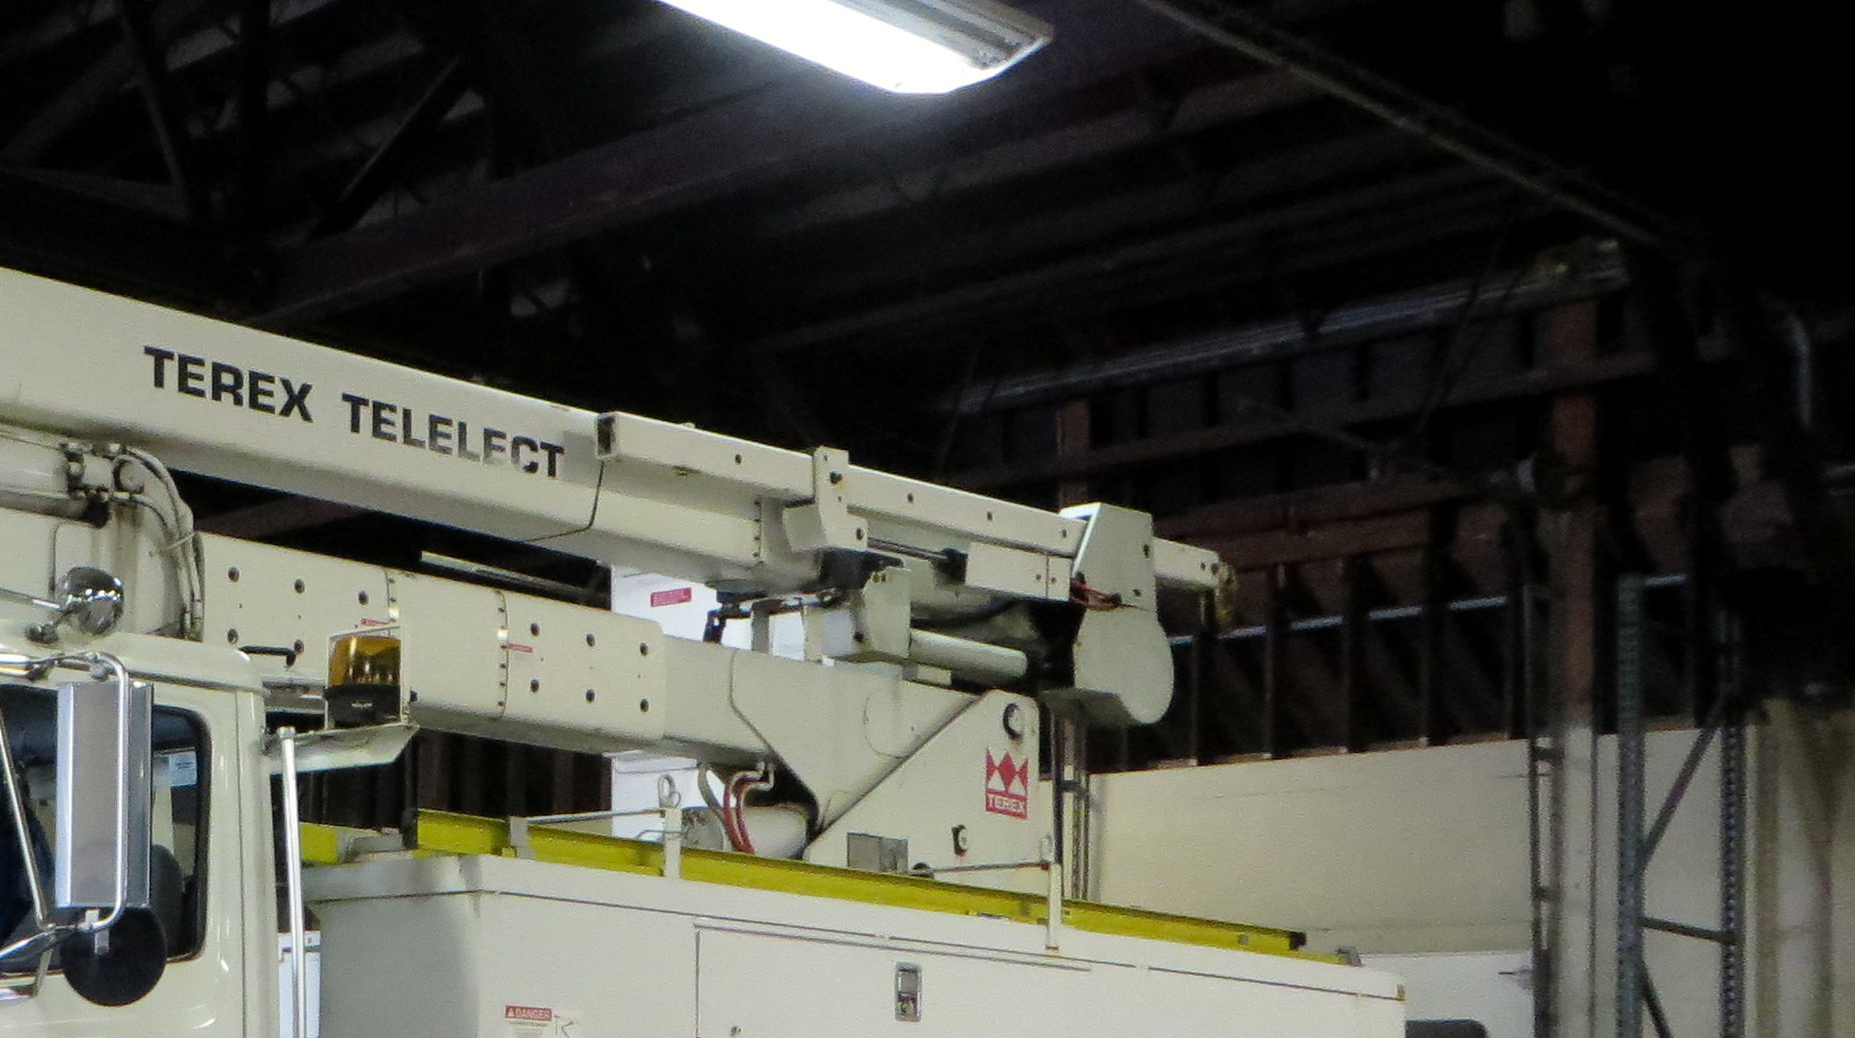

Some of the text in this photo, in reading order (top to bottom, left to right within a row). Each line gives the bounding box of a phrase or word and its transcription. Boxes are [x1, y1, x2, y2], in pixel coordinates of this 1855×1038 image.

[143, 345, 565, 478] TEREX TELELECT
[987, 793, 1027, 813] TEREX
[515, 1007, 550, 1021] DANGER
